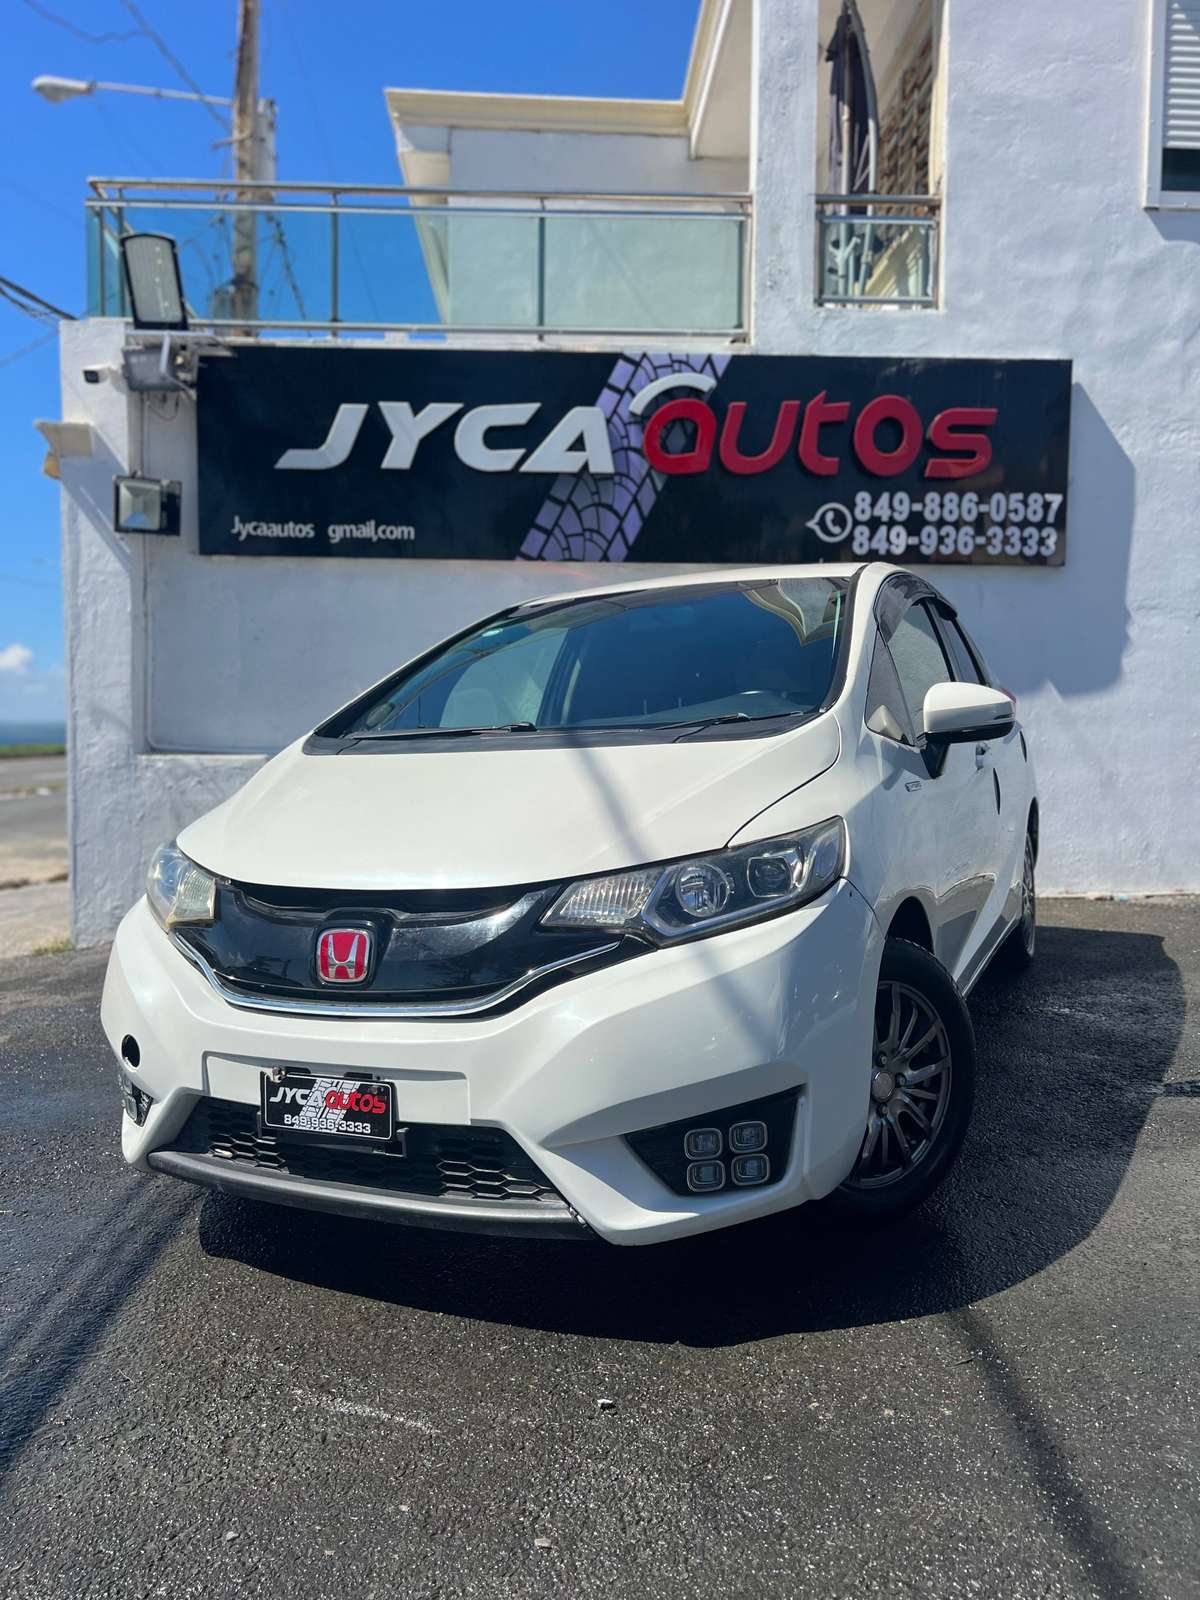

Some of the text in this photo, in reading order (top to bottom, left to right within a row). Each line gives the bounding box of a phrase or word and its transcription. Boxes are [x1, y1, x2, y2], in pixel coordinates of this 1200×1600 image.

[274, 401, 615, 473] JYCA
[854, 491, 1063, 524] 849-886-0587
[231, 515, 315, 541] Jycaautos
[851, 525, 1058, 556] 849-936-3333
[269, 1087, 322, 1108] JYCA
